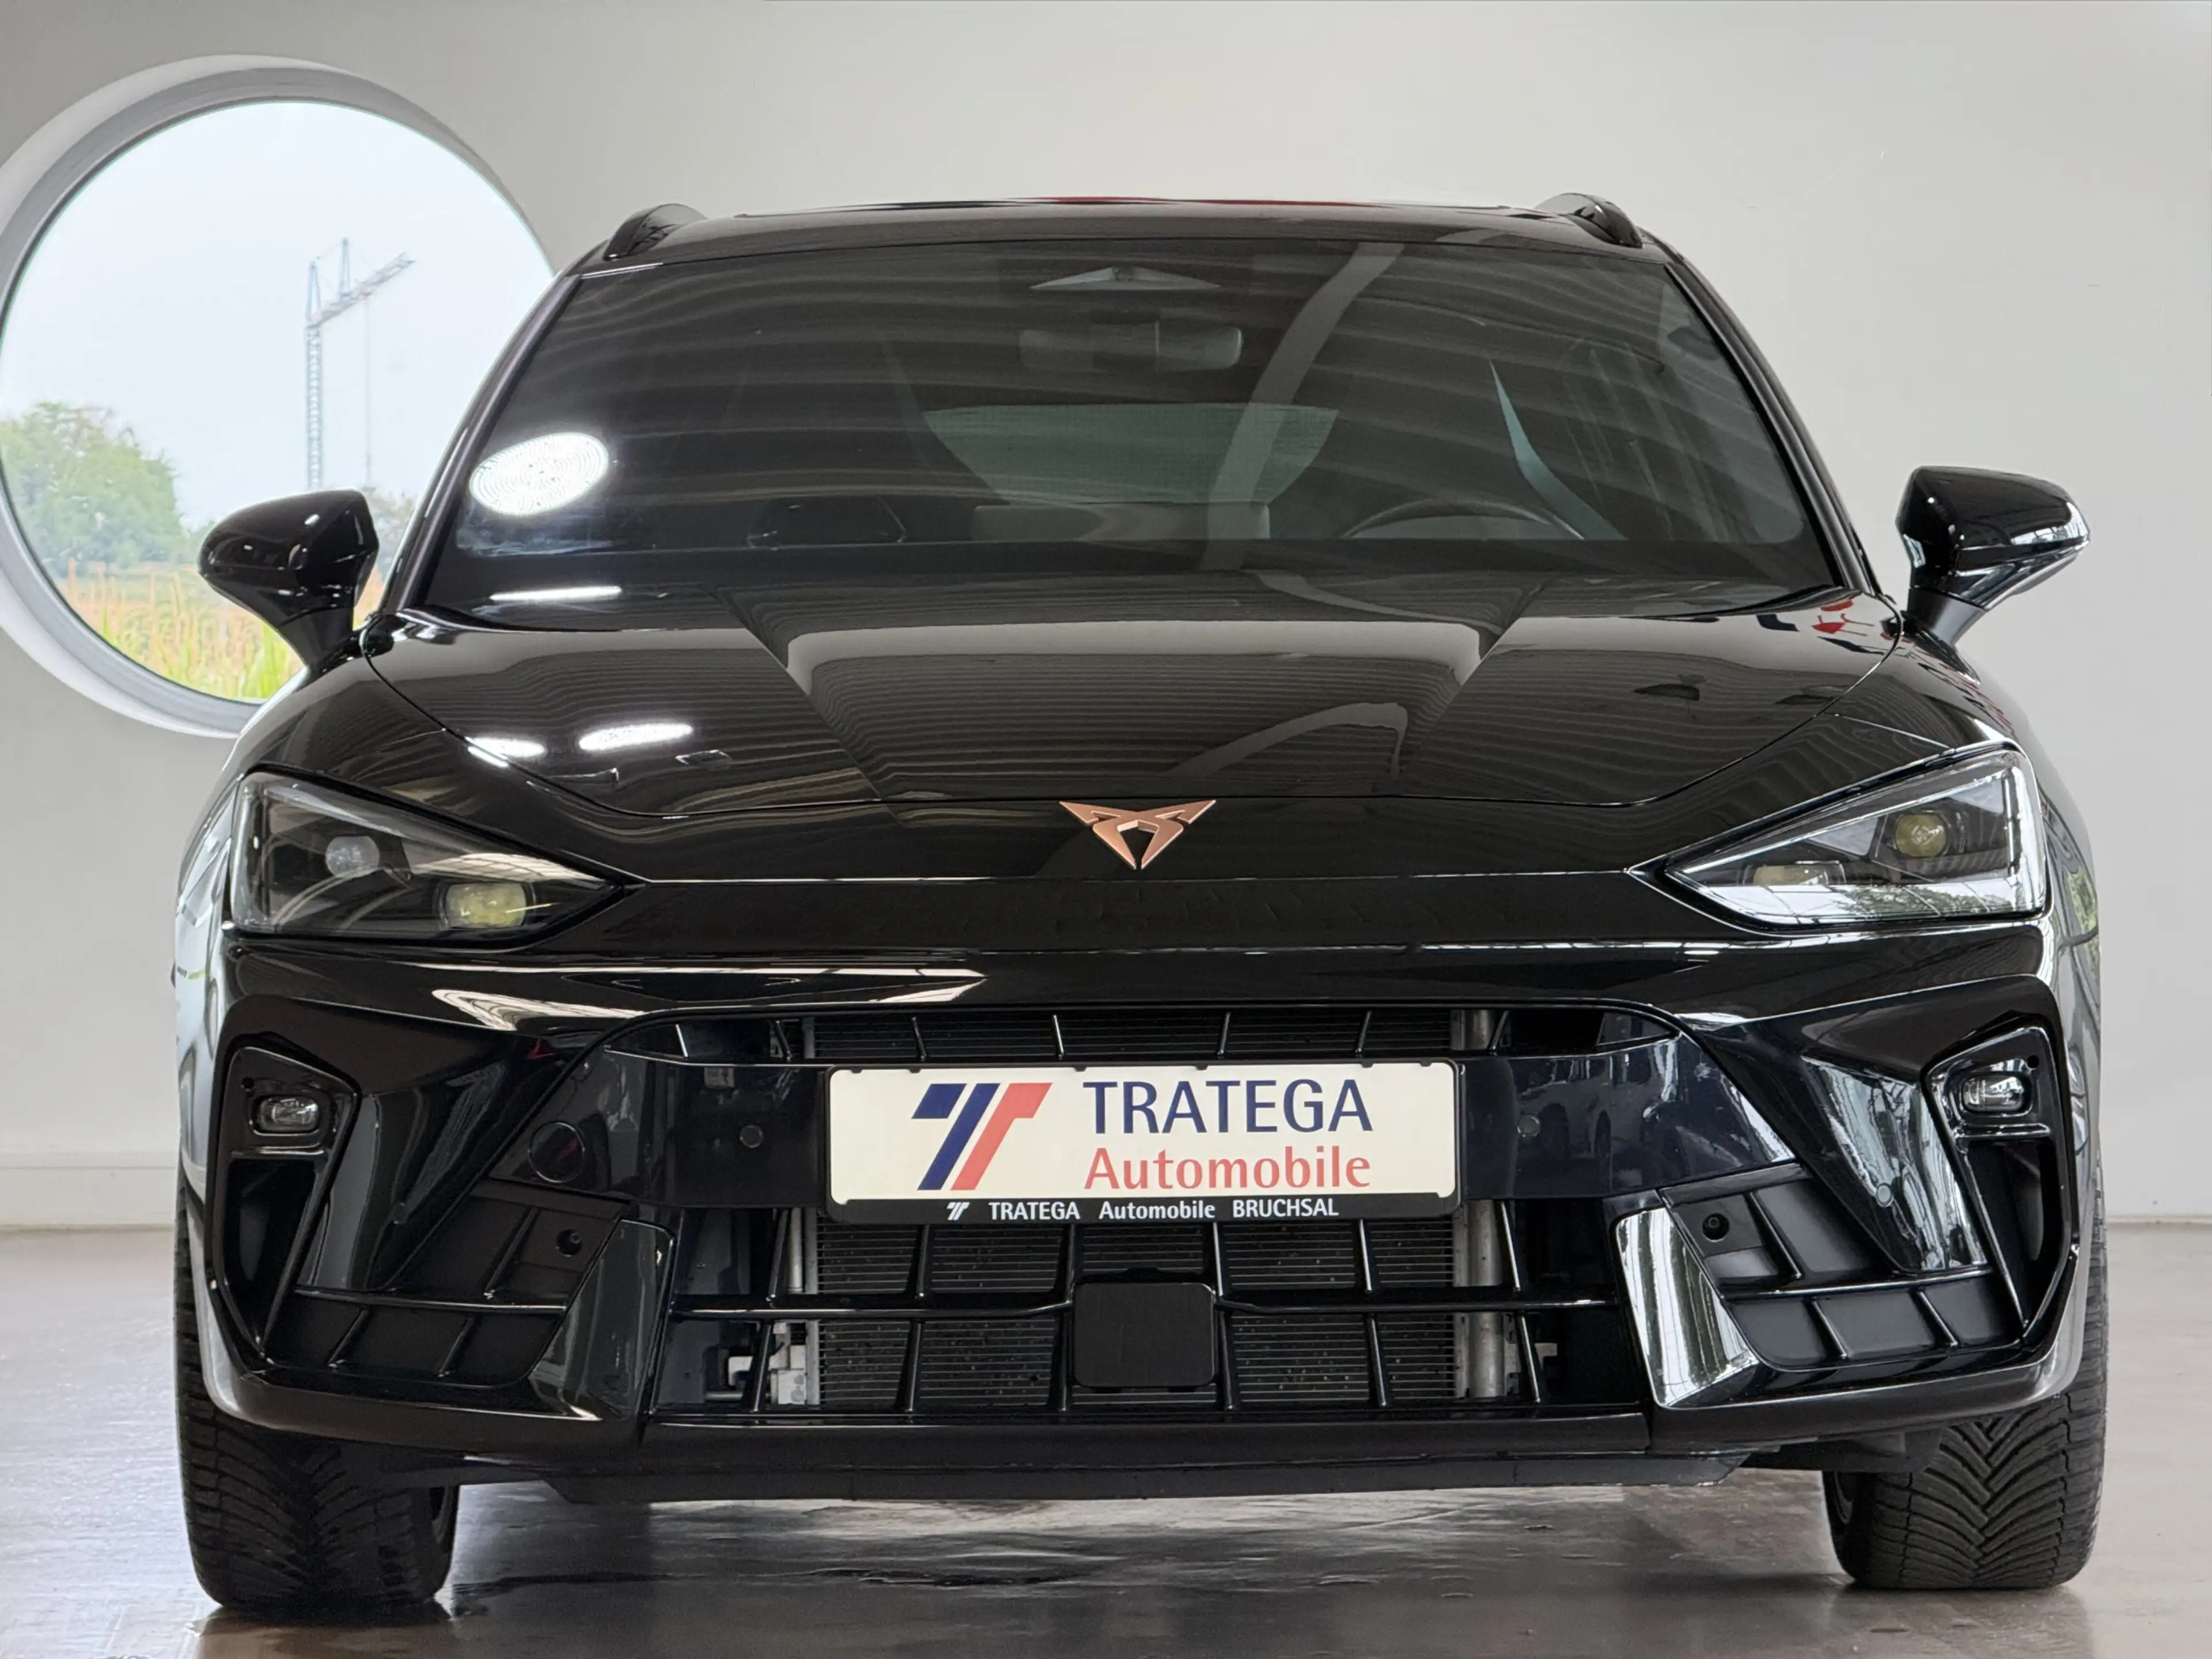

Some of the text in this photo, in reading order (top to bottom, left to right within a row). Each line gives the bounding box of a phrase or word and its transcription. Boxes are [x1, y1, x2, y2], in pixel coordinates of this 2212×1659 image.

[1082, 1079, 1373, 1134] TRATEGA
[1084, 1145, 1370, 1190] Automobile
[988, 1198, 1339, 1220] TRATEGA Automobile BRUCHSAL
